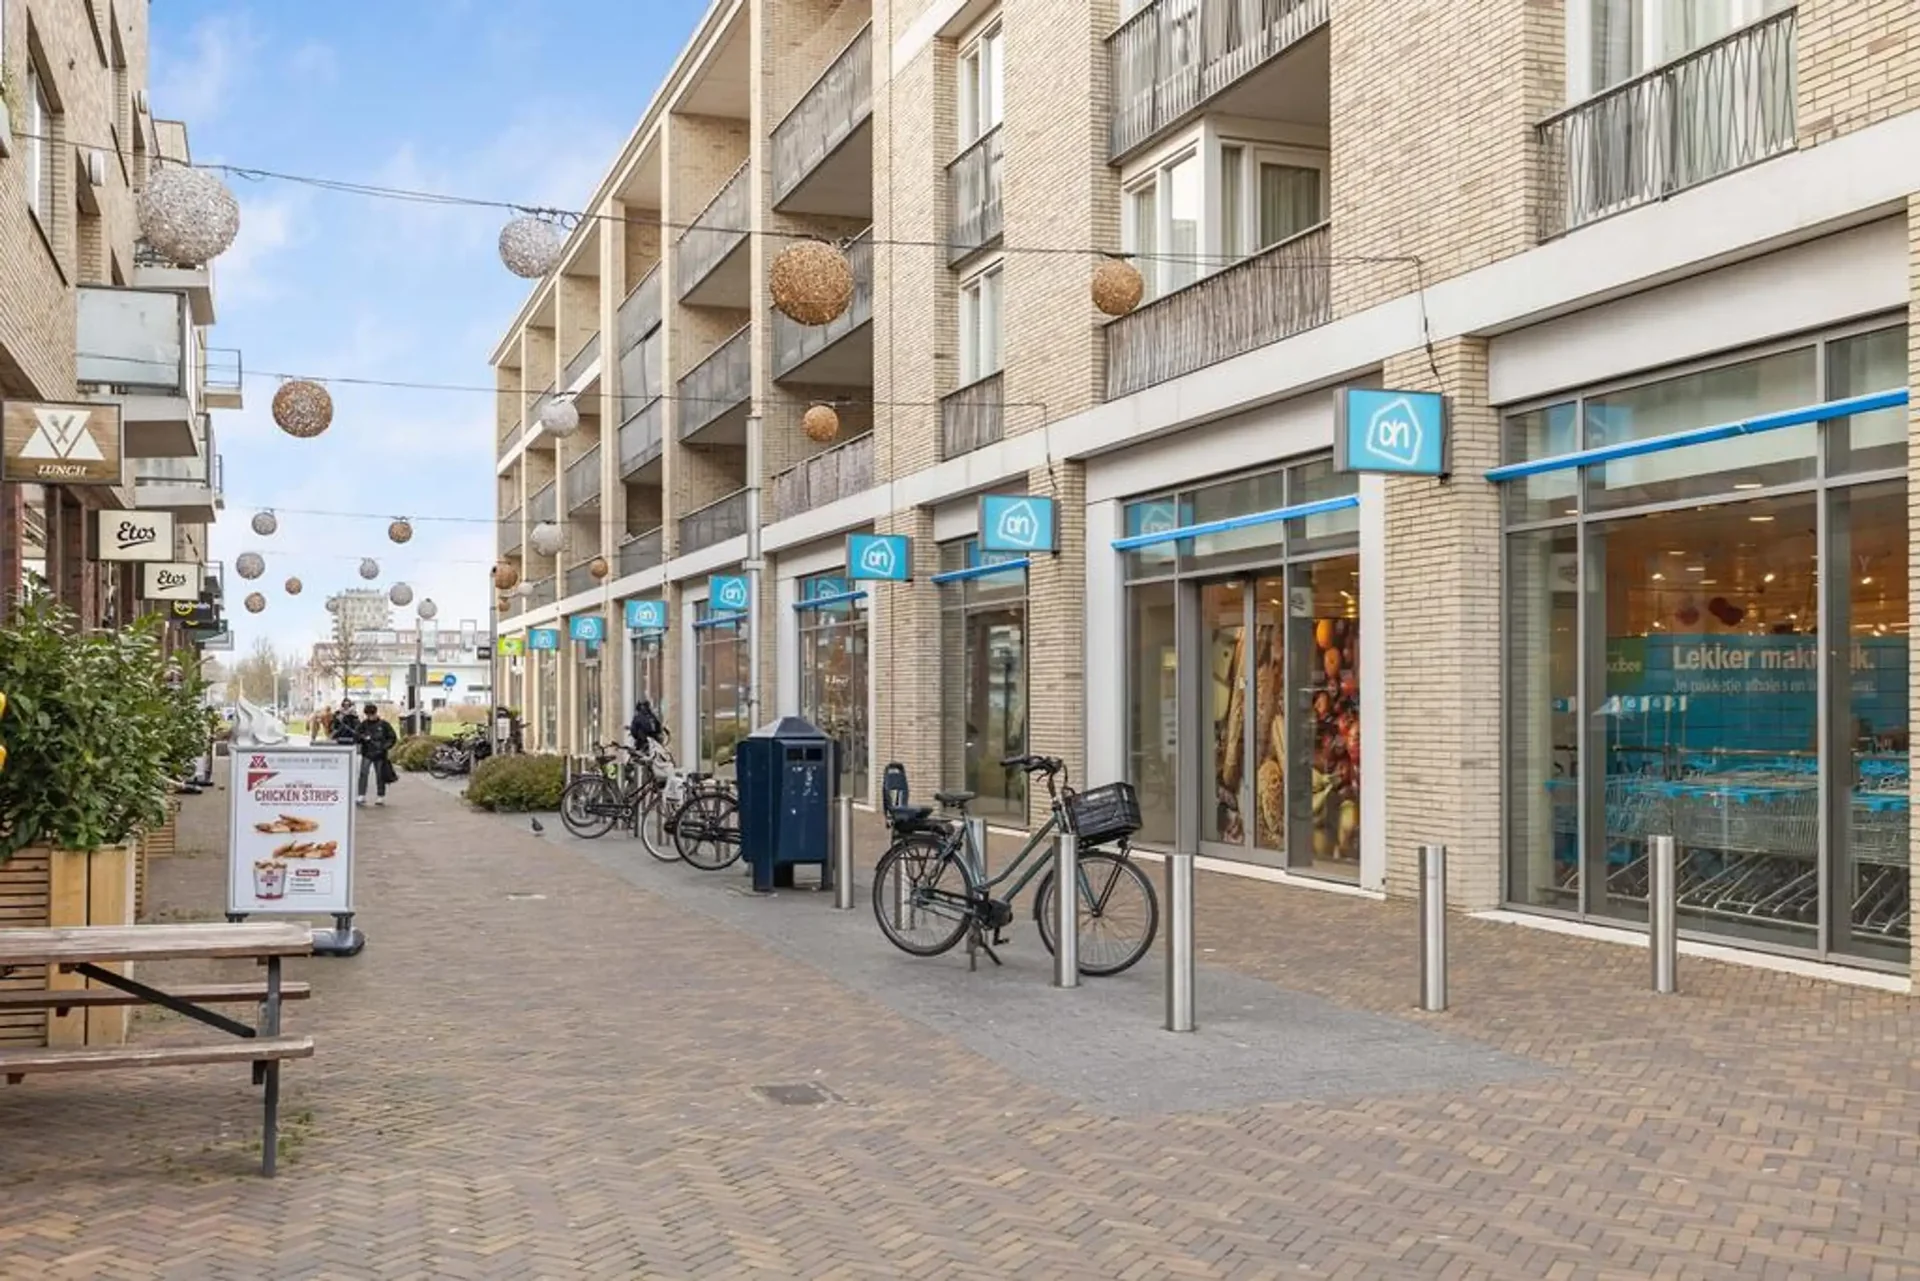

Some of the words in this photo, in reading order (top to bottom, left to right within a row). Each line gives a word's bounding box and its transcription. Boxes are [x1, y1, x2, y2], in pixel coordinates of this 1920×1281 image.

[36, 463, 88, 477] LUNCH
[116, 520, 156, 542] Etos
[157, 569, 187, 586] Etos
[1673, 643, 1752, 669] Lekker
[255, 789, 300, 801] CHICKEN
[302, 789, 339, 801] STRIPS
